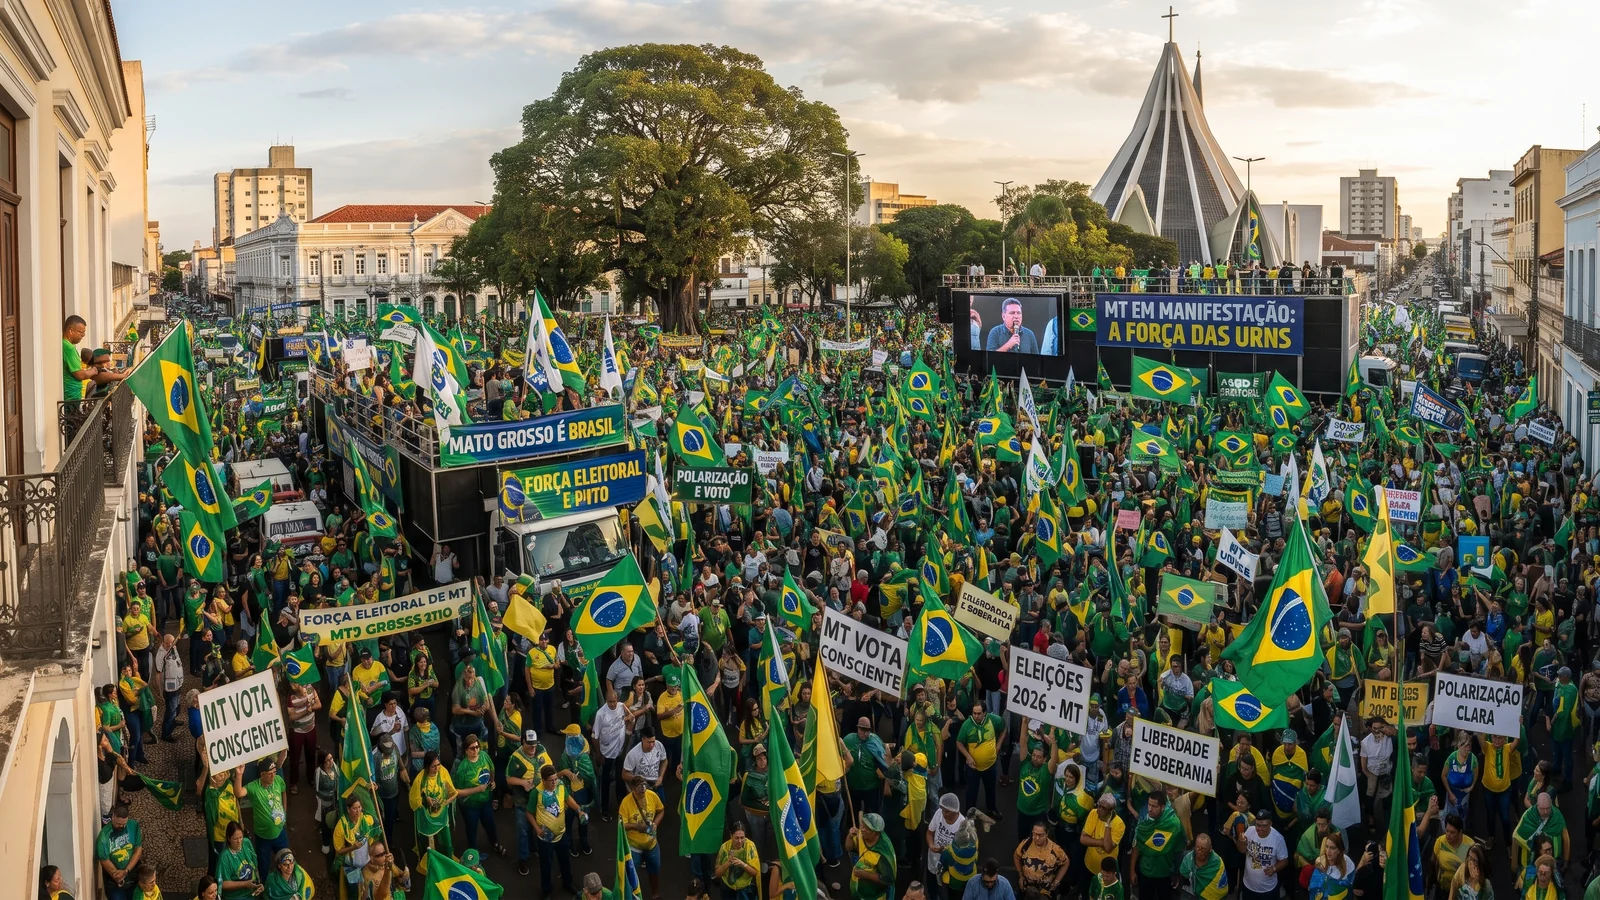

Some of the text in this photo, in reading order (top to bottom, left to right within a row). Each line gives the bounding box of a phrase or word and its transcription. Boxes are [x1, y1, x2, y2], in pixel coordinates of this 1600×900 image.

[1104, 300, 1296, 326] MT EM MANIFESTAÇÃO:
[1108, 321, 1292, 348] A FORÇA DAS URNS
[449, 417, 616, 456] MATO GROSSO É BRASIL
[524, 459, 643, 496] FORÇA ELEITORAL
[676, 470, 749, 488] POLARIZAÇÃO
[694, 485, 731, 499] E VOTO
[563, 491, 572, 509] E
[303, 586, 467, 627] FORÇA ELEITORAL DE MT
[960, 601, 966, 610] E
[823, 616, 902, 670] MT VOTA
[820, 644, 902, 692] CONSCIENTE
[1015, 655, 1084, 693] ELEIÇÕES
[203, 683, 273, 732] MT VOTA
[1012, 684, 1047, 713] 2026
[1059, 698, 1084, 724] MT
[1371, 685, 1388, 700] MT
[1437, 679, 1521, 708] POLARIZAÇÃO
[1456, 705, 1495, 726] CLARA
[209, 718, 283, 765] CONSCIENTE
[1141, 726, 1210, 760] LIBERDADE
[1133, 747, 1213, 786] E SOBERANIA
